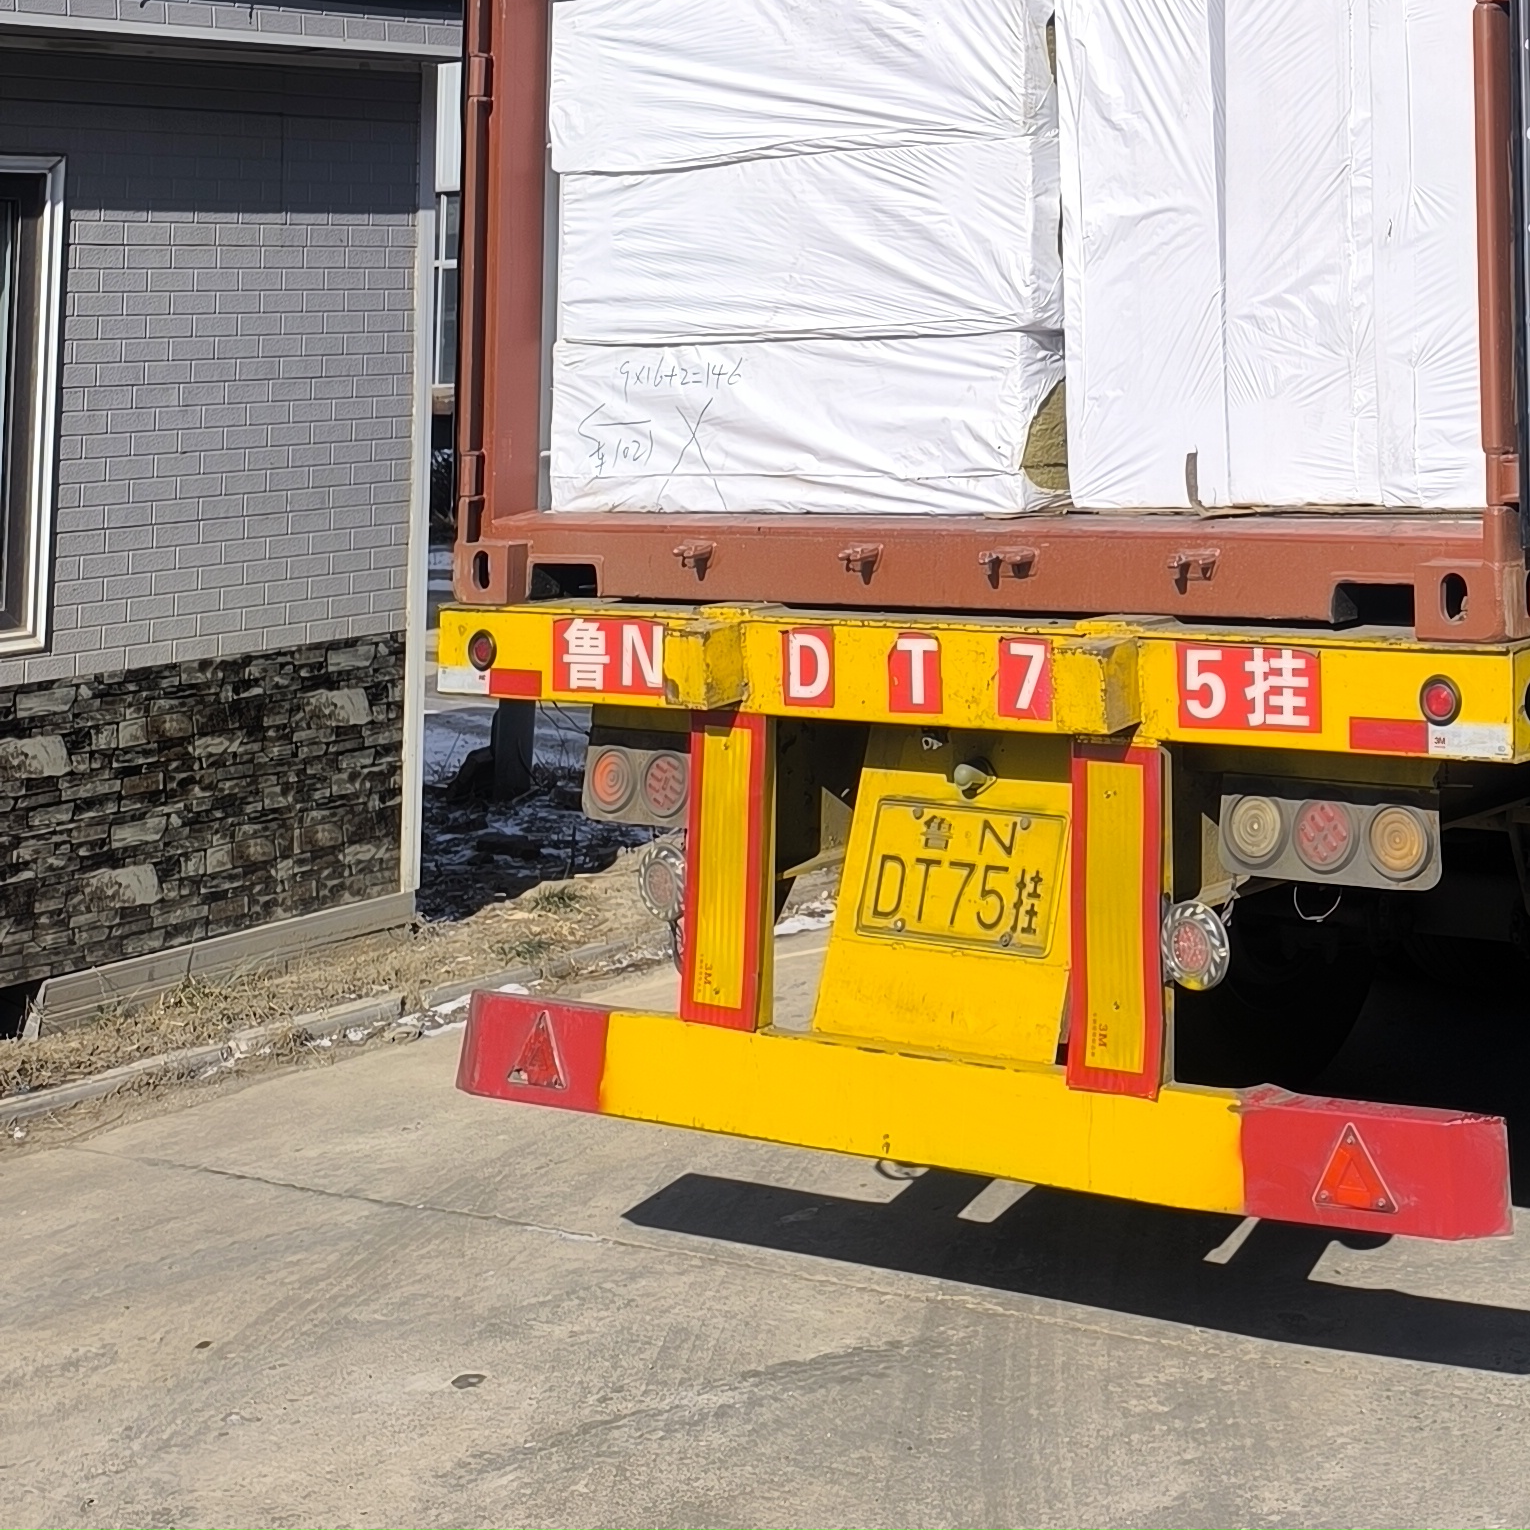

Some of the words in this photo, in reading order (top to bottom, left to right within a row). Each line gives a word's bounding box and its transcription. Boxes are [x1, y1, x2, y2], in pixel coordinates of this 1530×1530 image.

[563, 619, 663, 690] 鲁N
[788, 634, 829, 699] D
[897, 639, 938, 705] T
[1008, 642, 1046, 710] 7
[1185, 648, 1311, 727] 5挂
[872, 854, 1044, 935] DT75挂
